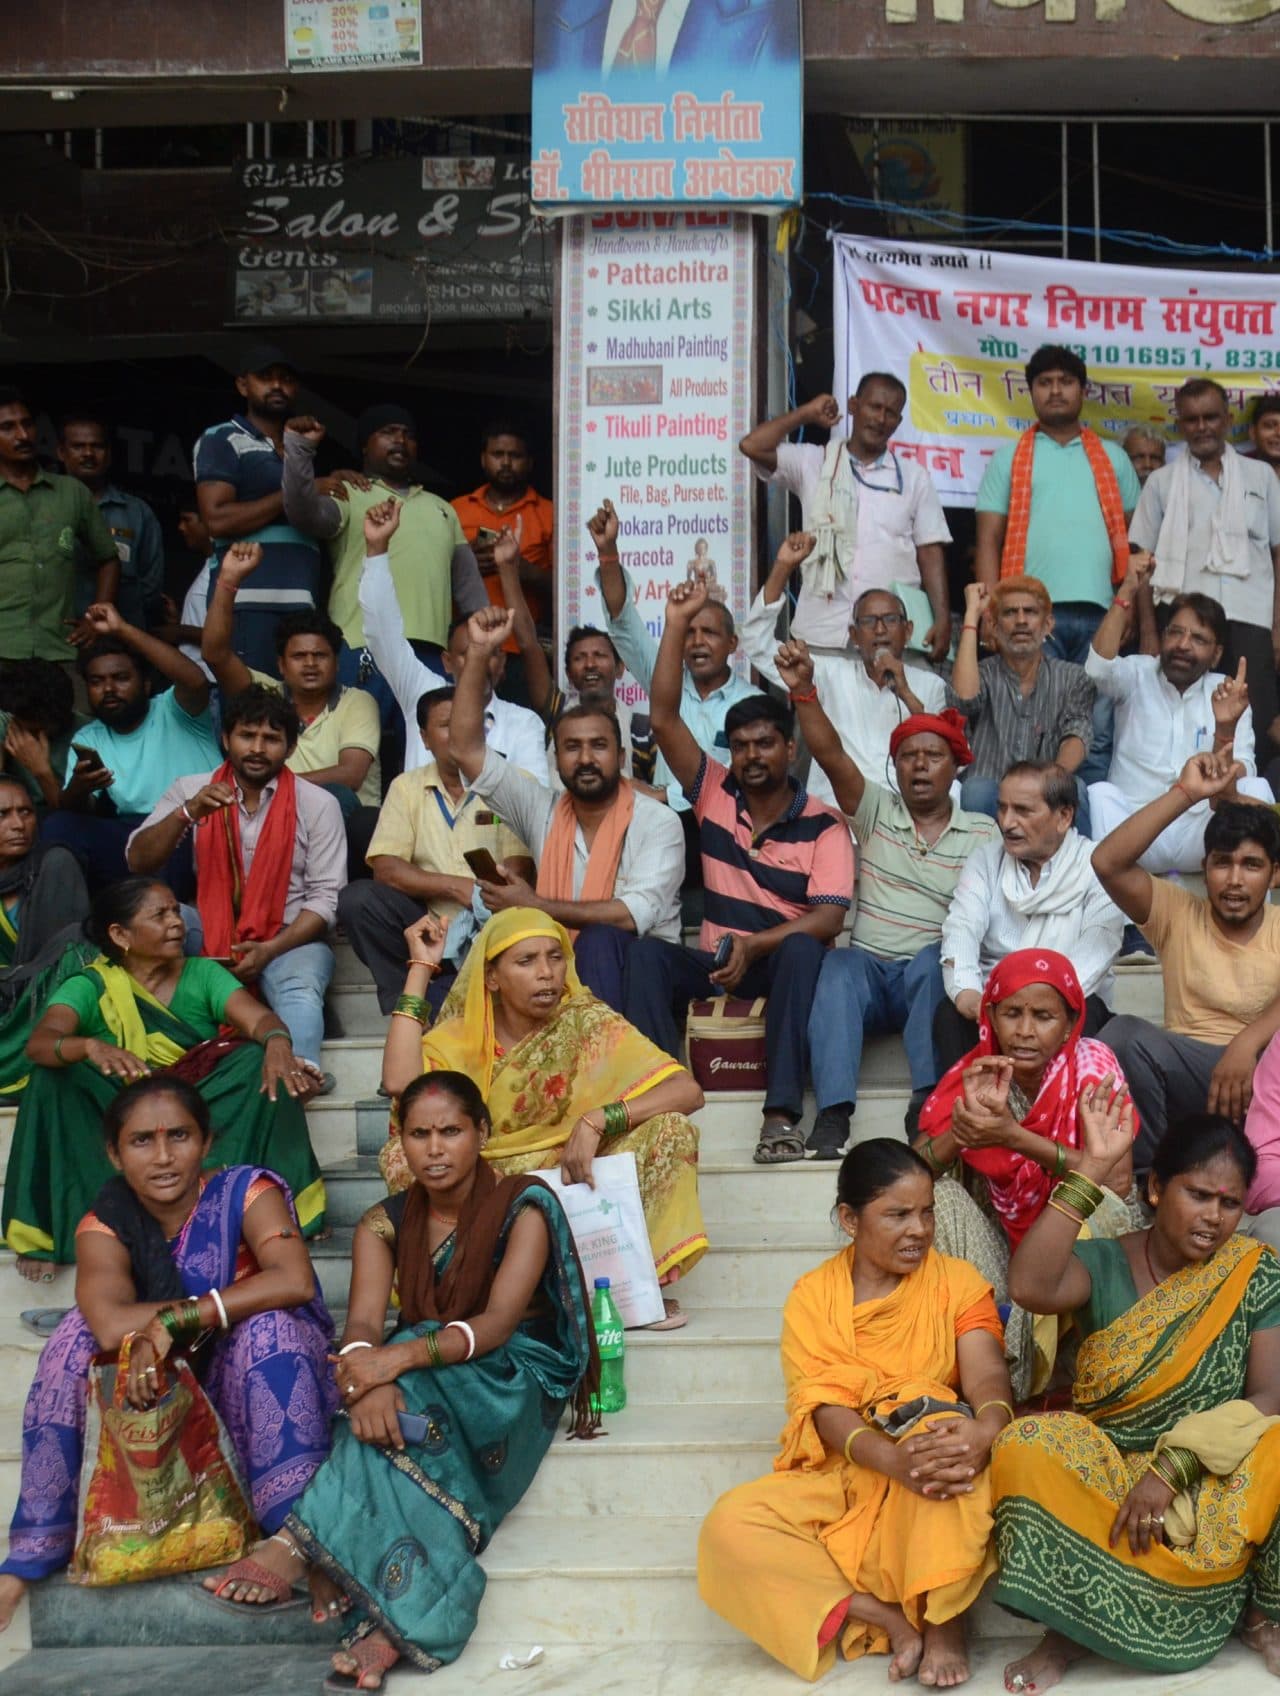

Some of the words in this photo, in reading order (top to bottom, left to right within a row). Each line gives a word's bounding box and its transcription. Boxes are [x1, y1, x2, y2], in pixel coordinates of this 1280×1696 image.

[564, 92, 665, 142] संविधान
[671, 90, 764, 142] निर्माता
[243, 162, 344, 188] GLAMS
[582, 149, 675, 199] भीमराव
[237, 196, 399, 239] Salon
[418, 193, 460, 234] &
[239, 247, 338, 268] Gents
[606, 260, 729, 286] Pattachitra
[607, 298, 661, 322] Sikki
[667, 297, 712, 320] Arts
[858, 277, 942, 321] पटना
[953, 290, 1032, 327] नगर
[1044, 284, 1147, 331] निगम
[1159, 287, 1277, 347] संयुक्त
[606, 336, 674, 361] Madhubani
[678, 334, 728, 362] Painting
[670, 379, 683, 398] All
[685, 377, 728, 398] Products
[924, 361, 984, 399] तीन
[604, 414, 651, 439] Tikuli
[656, 413, 728, 440] Painting
[604, 456, 642, 478] Jute
[648, 453, 727, 477] Products
[620, 485, 643, 506] File,
[646, 484, 671, 507] Bag,
[674, 483, 705, 502] Purse
[707, 482, 728, 501] etc.
[667, 513, 729, 535] Products
[596, 1328, 622, 1346] rite
